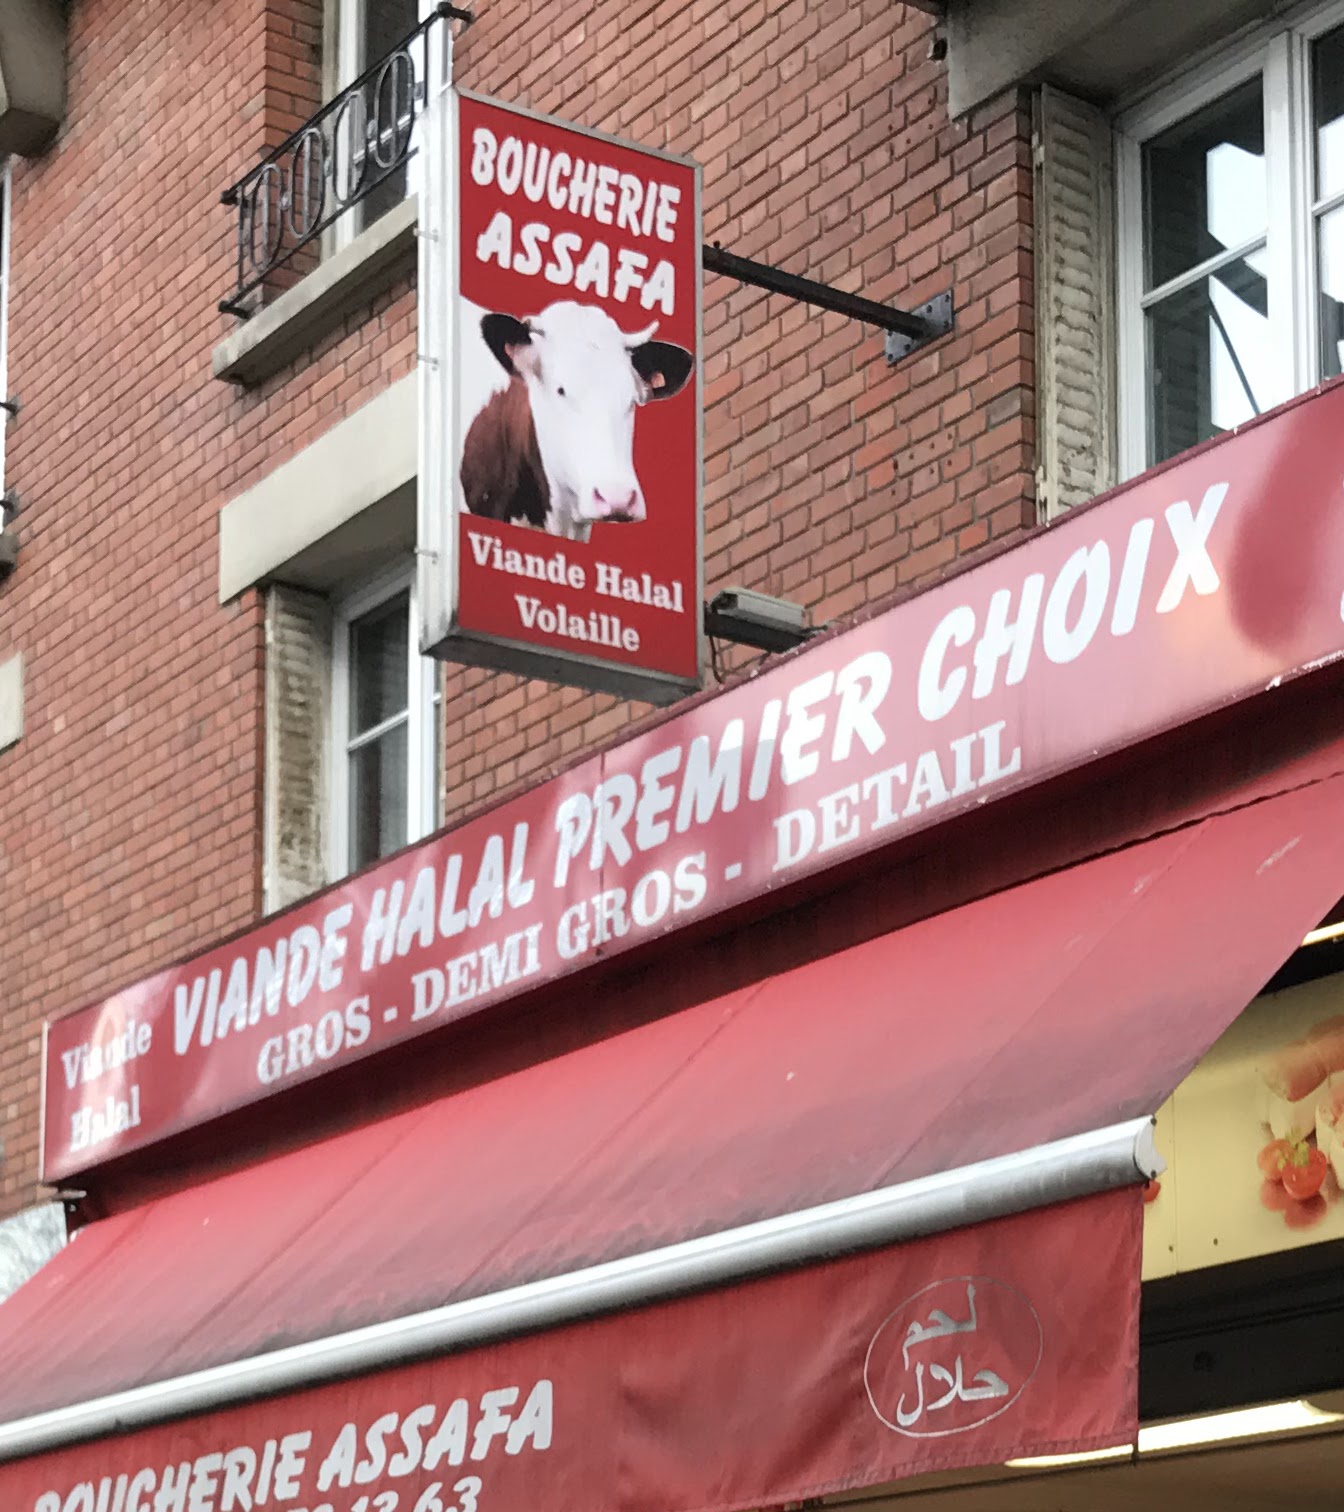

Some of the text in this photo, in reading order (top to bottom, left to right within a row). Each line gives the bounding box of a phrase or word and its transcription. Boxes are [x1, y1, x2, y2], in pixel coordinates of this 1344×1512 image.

[471, 127, 682, 243] BOUCHERIE
[475, 212, 677, 316] ASSAFA
[467, 531, 685, 614] Viande Halal
[514, 594, 641, 652] Volaille
[172, 482, 1231, 1057] VIANDE HALAL PREMIER CHOIX
[257, 995, 372, 1085] GROS
[411, 924, 542, 1022] DEMI
[557, 851, 708, 960] GROS
[772, 720, 1022, 872] DETAIL
[61, 1019, 152, 1090] Viande
[70, 1084, 142, 1153] Halal
[902, 1282, 977, 1371] لحم
[896, 1354, 1009, 1427] حلال
[317, 1379, 554, 1492] ASSAFA
